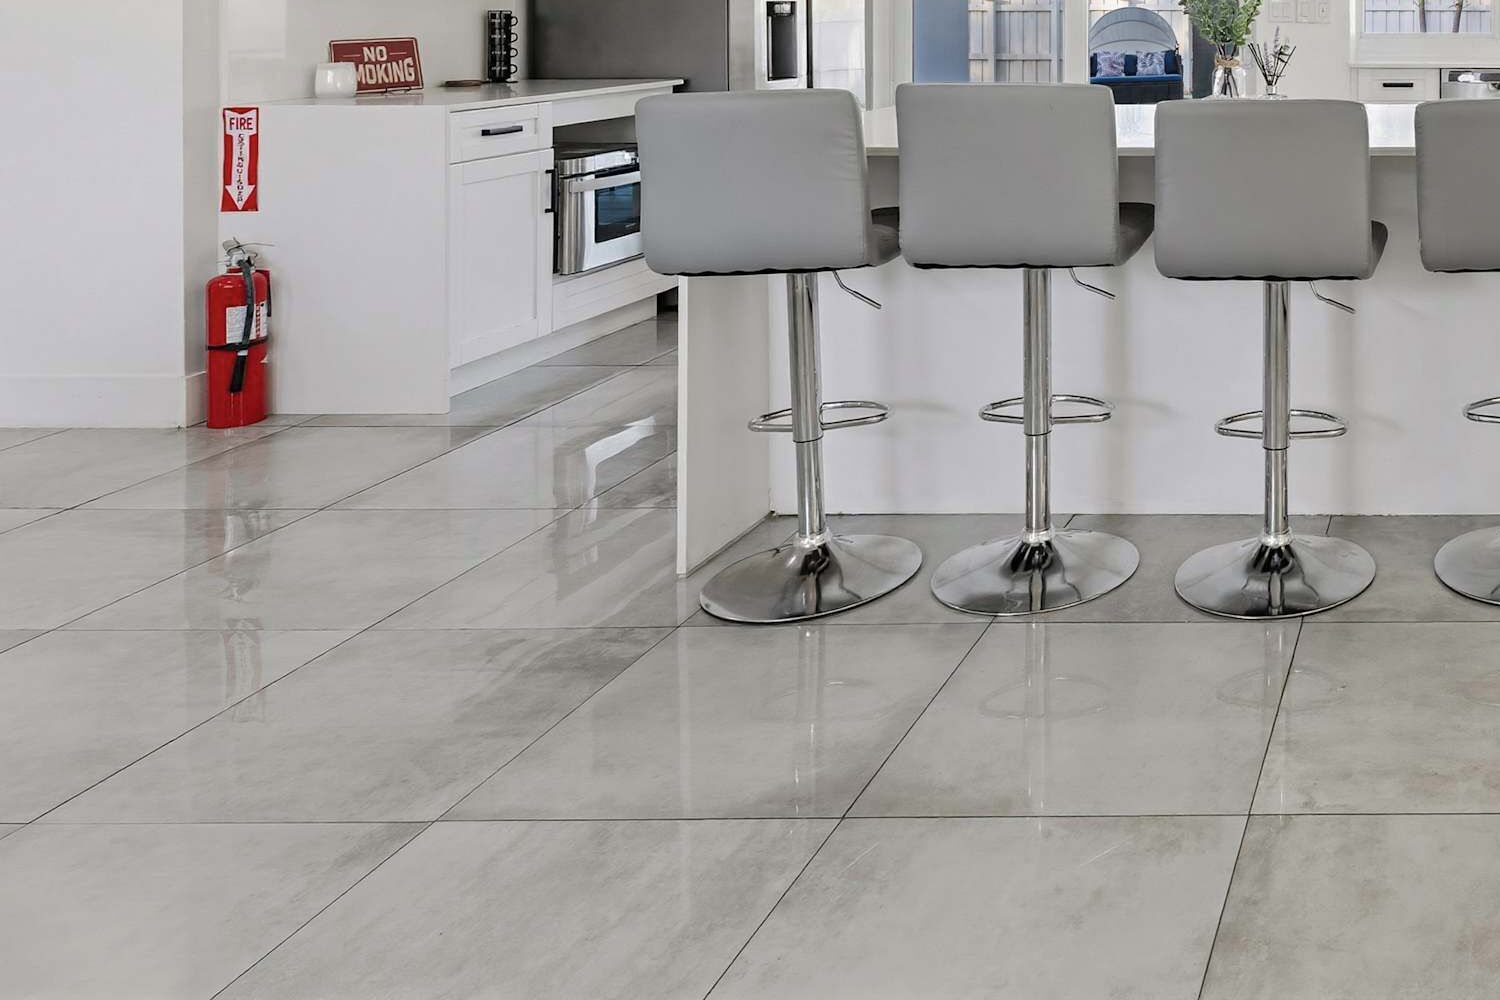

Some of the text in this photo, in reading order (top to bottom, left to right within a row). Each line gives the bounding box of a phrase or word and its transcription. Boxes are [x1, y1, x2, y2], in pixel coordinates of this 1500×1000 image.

[362, 45, 388, 62] NO
[355, 57, 415, 85] MOKING
[229, 117, 254, 131] FIRE
